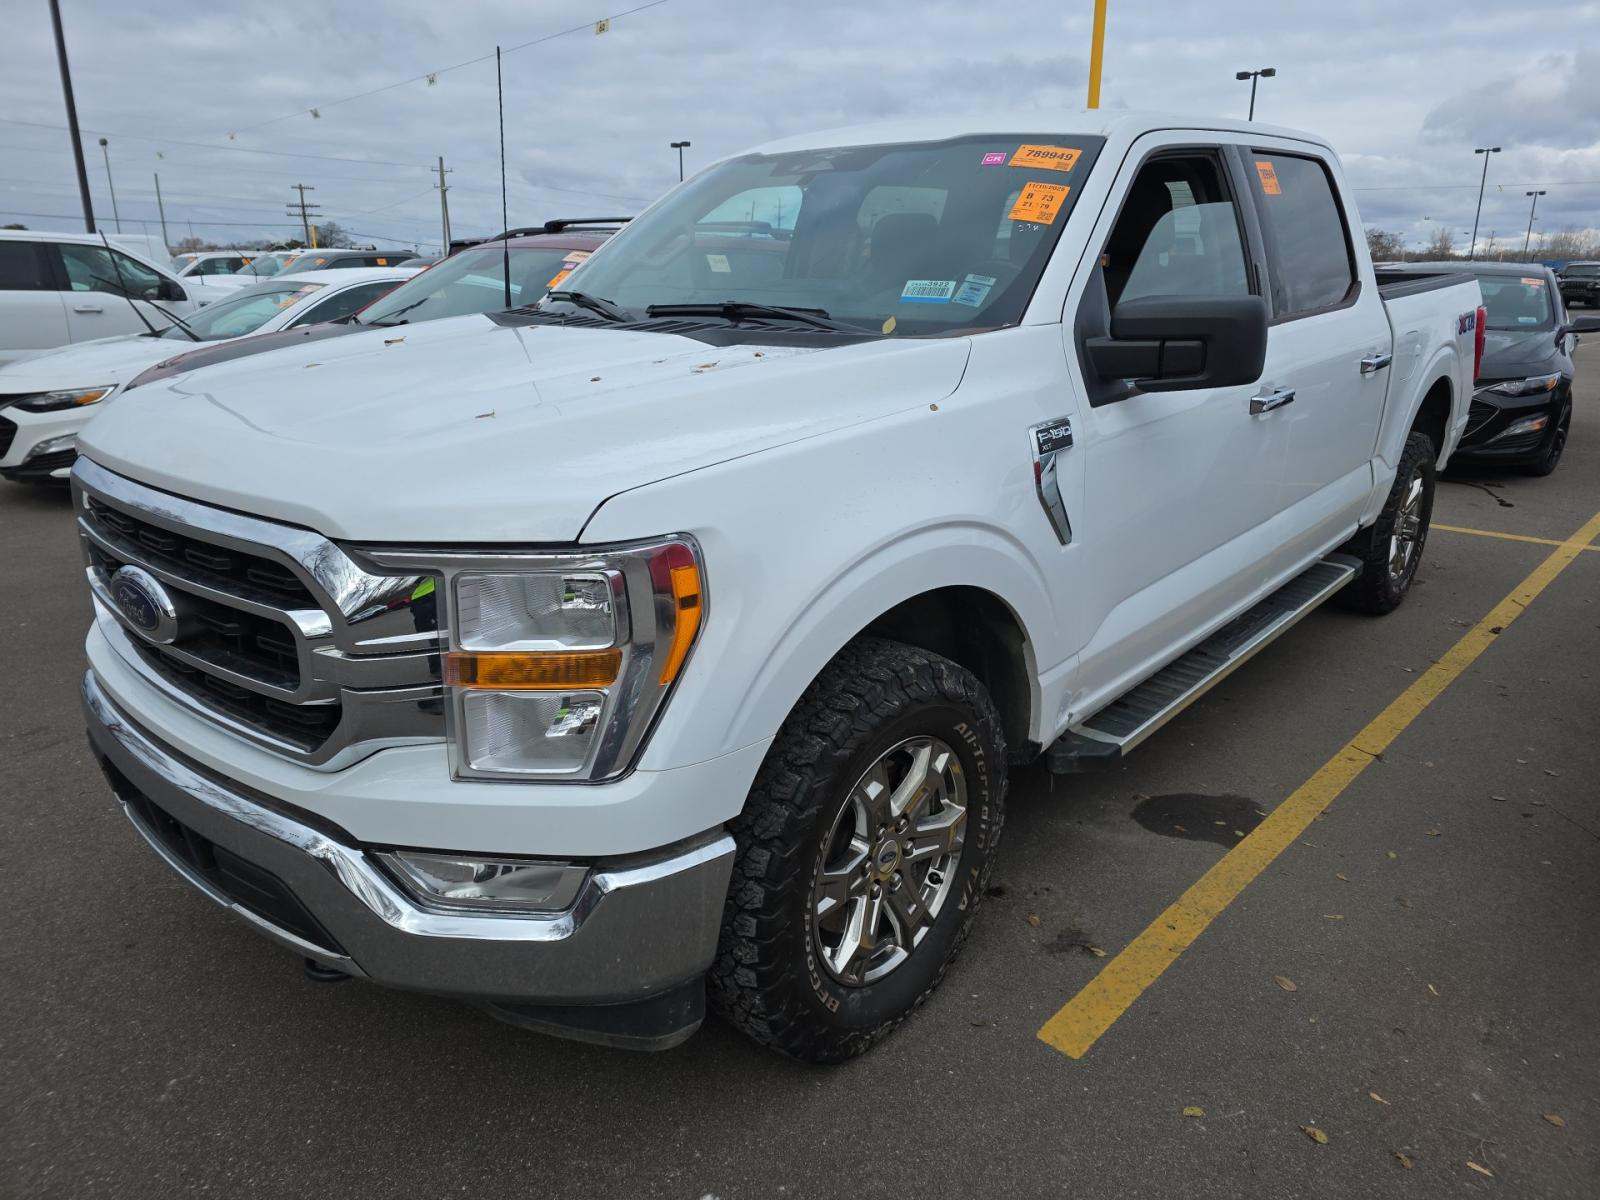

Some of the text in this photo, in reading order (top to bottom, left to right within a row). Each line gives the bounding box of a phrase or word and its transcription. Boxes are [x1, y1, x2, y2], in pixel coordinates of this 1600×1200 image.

[1026, 149, 1074, 161] 789949
[1041, 194, 1054, 202] 73
[1037, 425, 1072, 444] F-150
[1041, 442, 1052, 452] XLT
[119, 586, 147, 625] Ford
